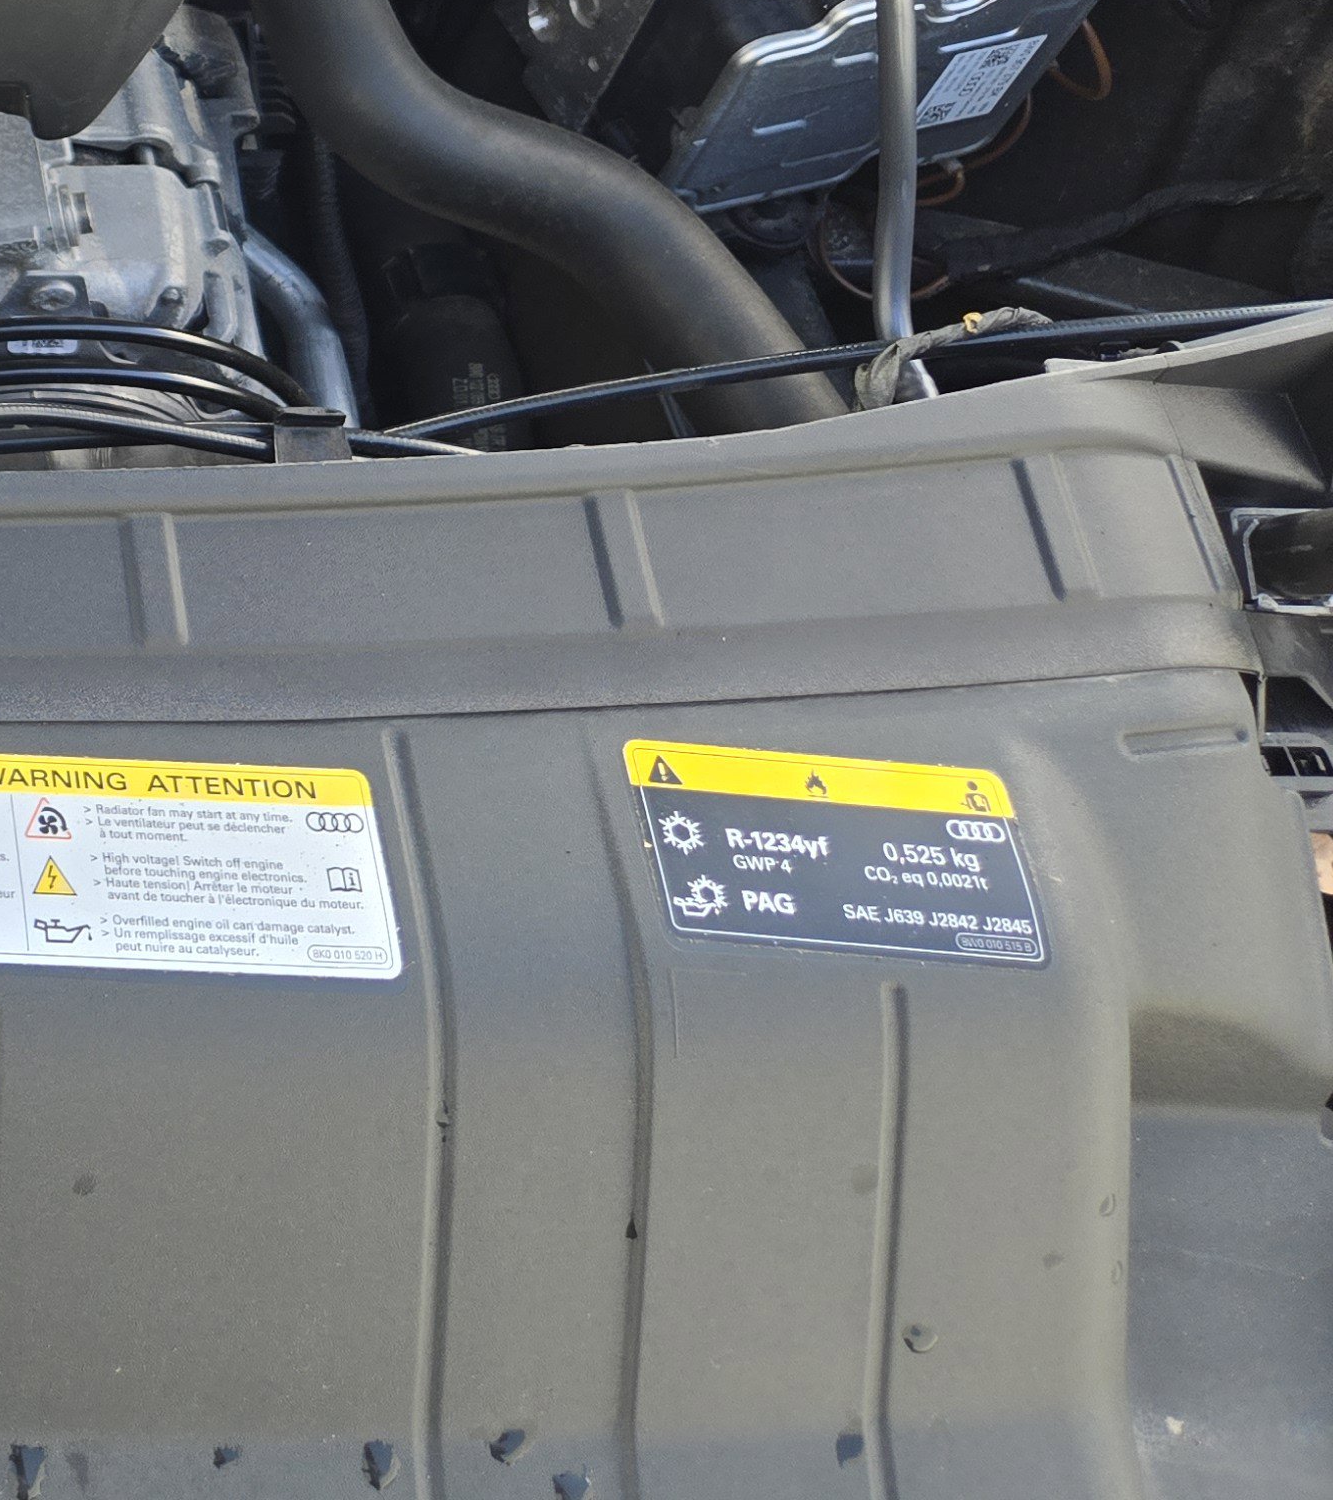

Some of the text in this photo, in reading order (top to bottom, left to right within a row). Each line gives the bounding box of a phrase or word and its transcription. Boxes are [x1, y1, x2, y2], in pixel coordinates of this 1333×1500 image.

[147, 774, 316, 799] ATTENTION
[96, 804, 292, 823] Radiator fan may start at any time.
[97, 817, 285, 834] Le ventilateur peut se déclencher
[100, 828, 187, 842] à tout moment.
[725, 828, 828, 859] R-1234yf
[103, 853, 283, 871] High voltage! Switch off engine
[733, 854, 792, 873] GWP 4
[950, 847, 980, 872] kg
[105, 864, 307, 884] before touching engine electronics.
[902, 872, 924, 888] eq
[106, 877, 139, 888] Haute
[237, 882, 247, 893] le
[251, 884, 292, 895] moteur
[107, 891, 139, 902] avant
[144, 890, 157, 902] de
[161, 892, 205, 904] toucher
[208, 892, 215, 904] à
[301, 898, 315, 908] du
[319, 900, 364, 910] moteur.
[741, 890, 796, 915] PAG
[113, 914, 355, 937] Overfilled engine oil can damage catalyst.
[843, 904, 1032, 934] SAE J639 J2842 J2845
[114, 927, 299, 945] Un remplissage excessif d'huile
[986, 939, 1003, 949] 010
[115, 941, 259, 958] peut nuire au catalyseur.
[334, 950, 351, 959] 010
[355, 950, 372, 960] 520
[375, 951, 382, 959] H
